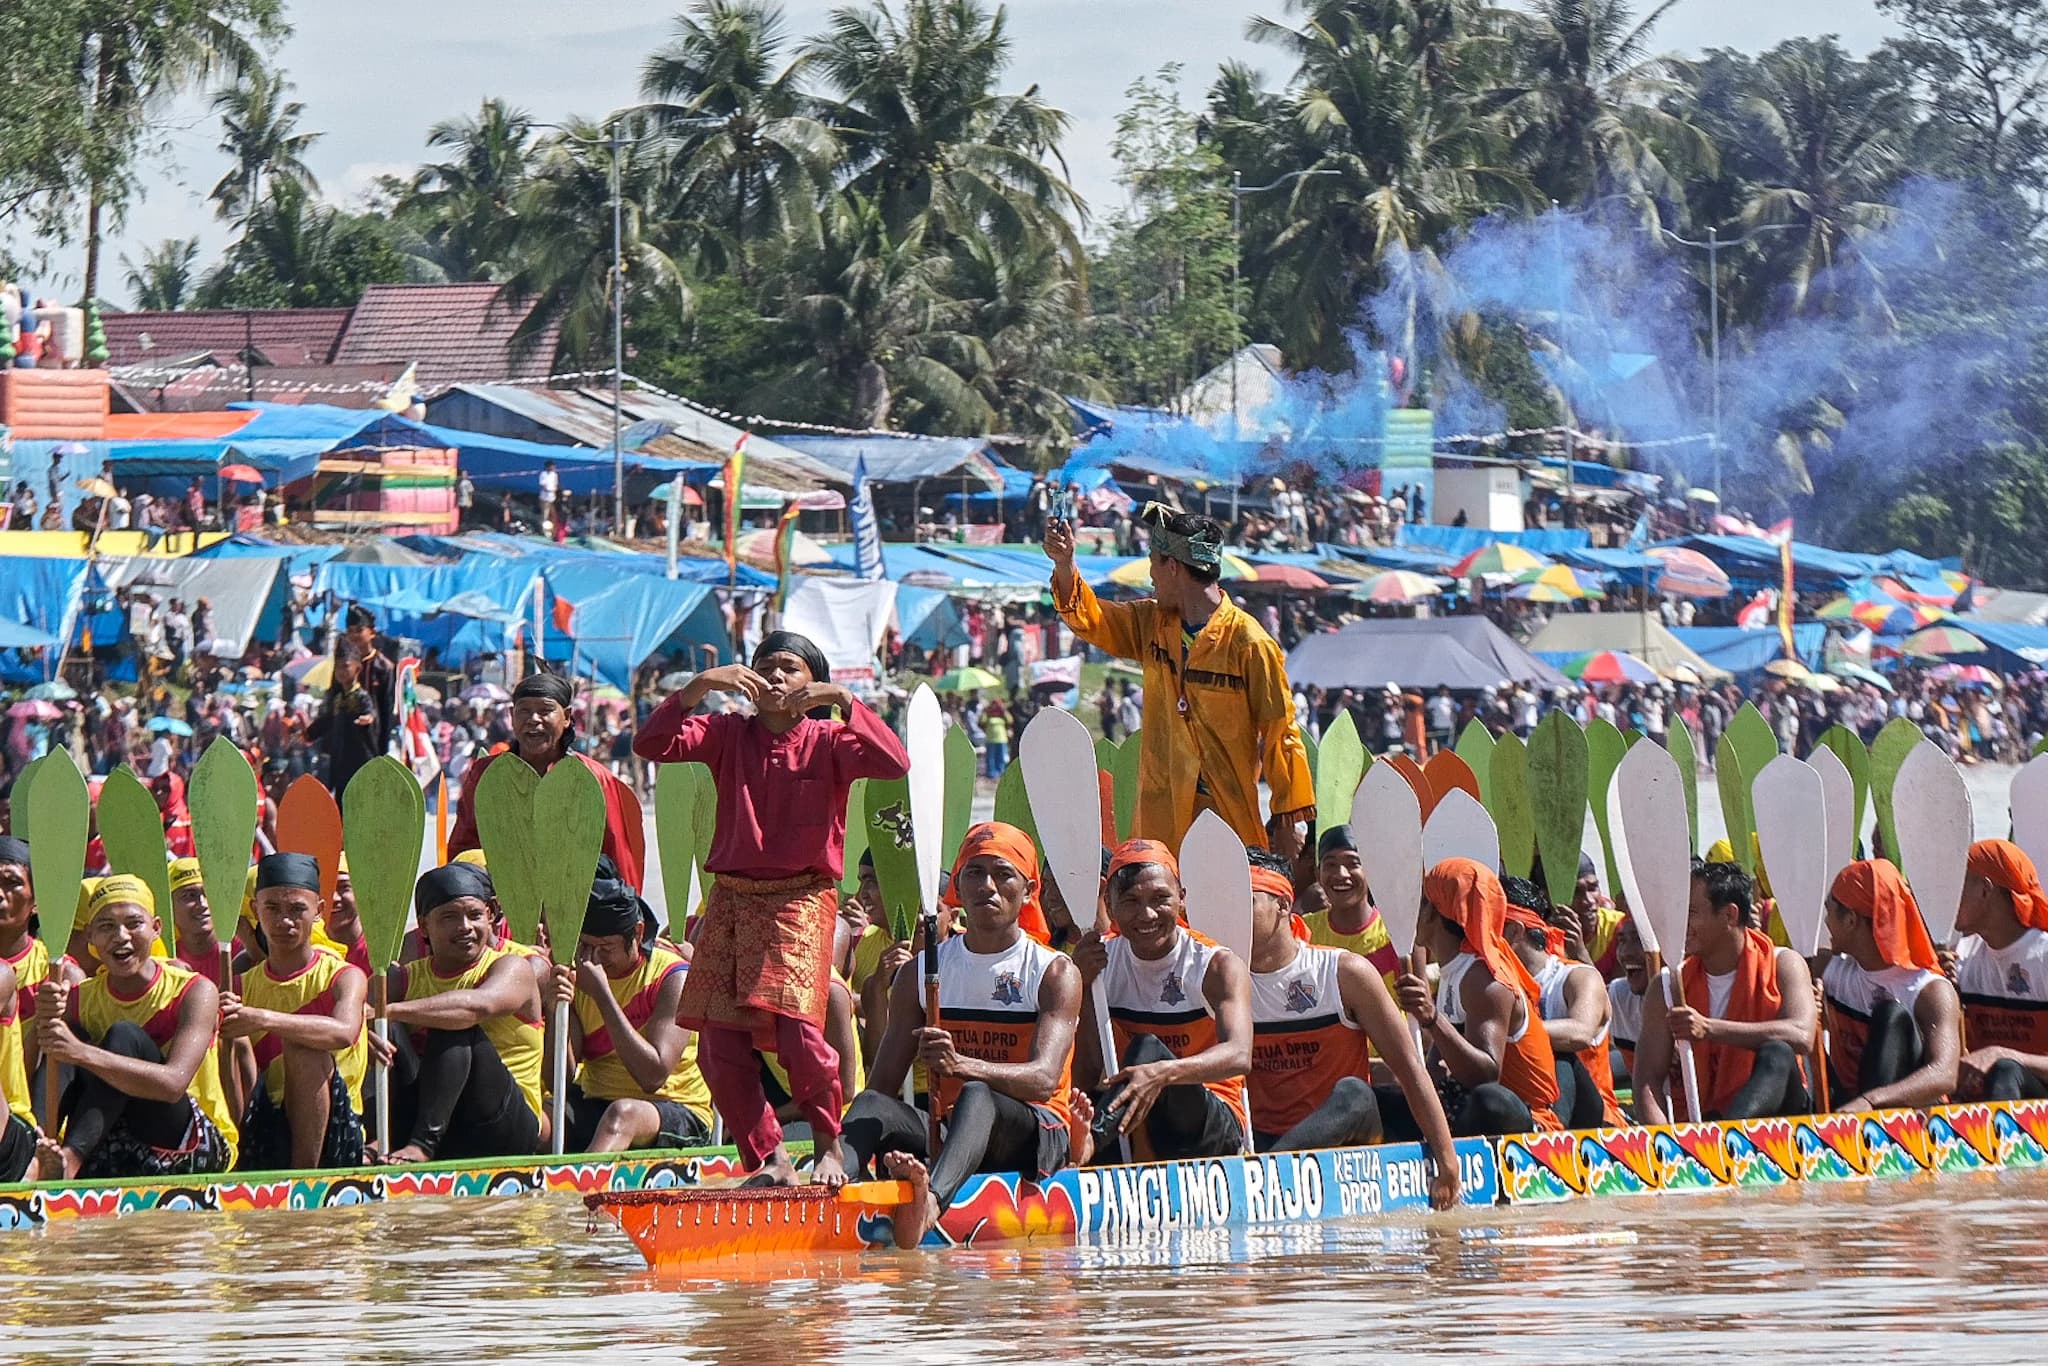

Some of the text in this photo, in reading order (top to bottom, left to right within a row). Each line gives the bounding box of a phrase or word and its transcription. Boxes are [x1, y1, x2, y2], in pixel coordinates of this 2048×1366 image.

[983, 1031, 1018, 1047] DPRD
[1161, 1034, 1190, 1048] PRD
[1286, 1041, 1320, 1056] DPRD
[1333, 1151, 1382, 1183] KETUA
[1386, 1153, 1484, 1200] BENGLIS
[1244, 1157, 1323, 1222] RAJO
[1341, 1181, 1382, 1215] DPRD
